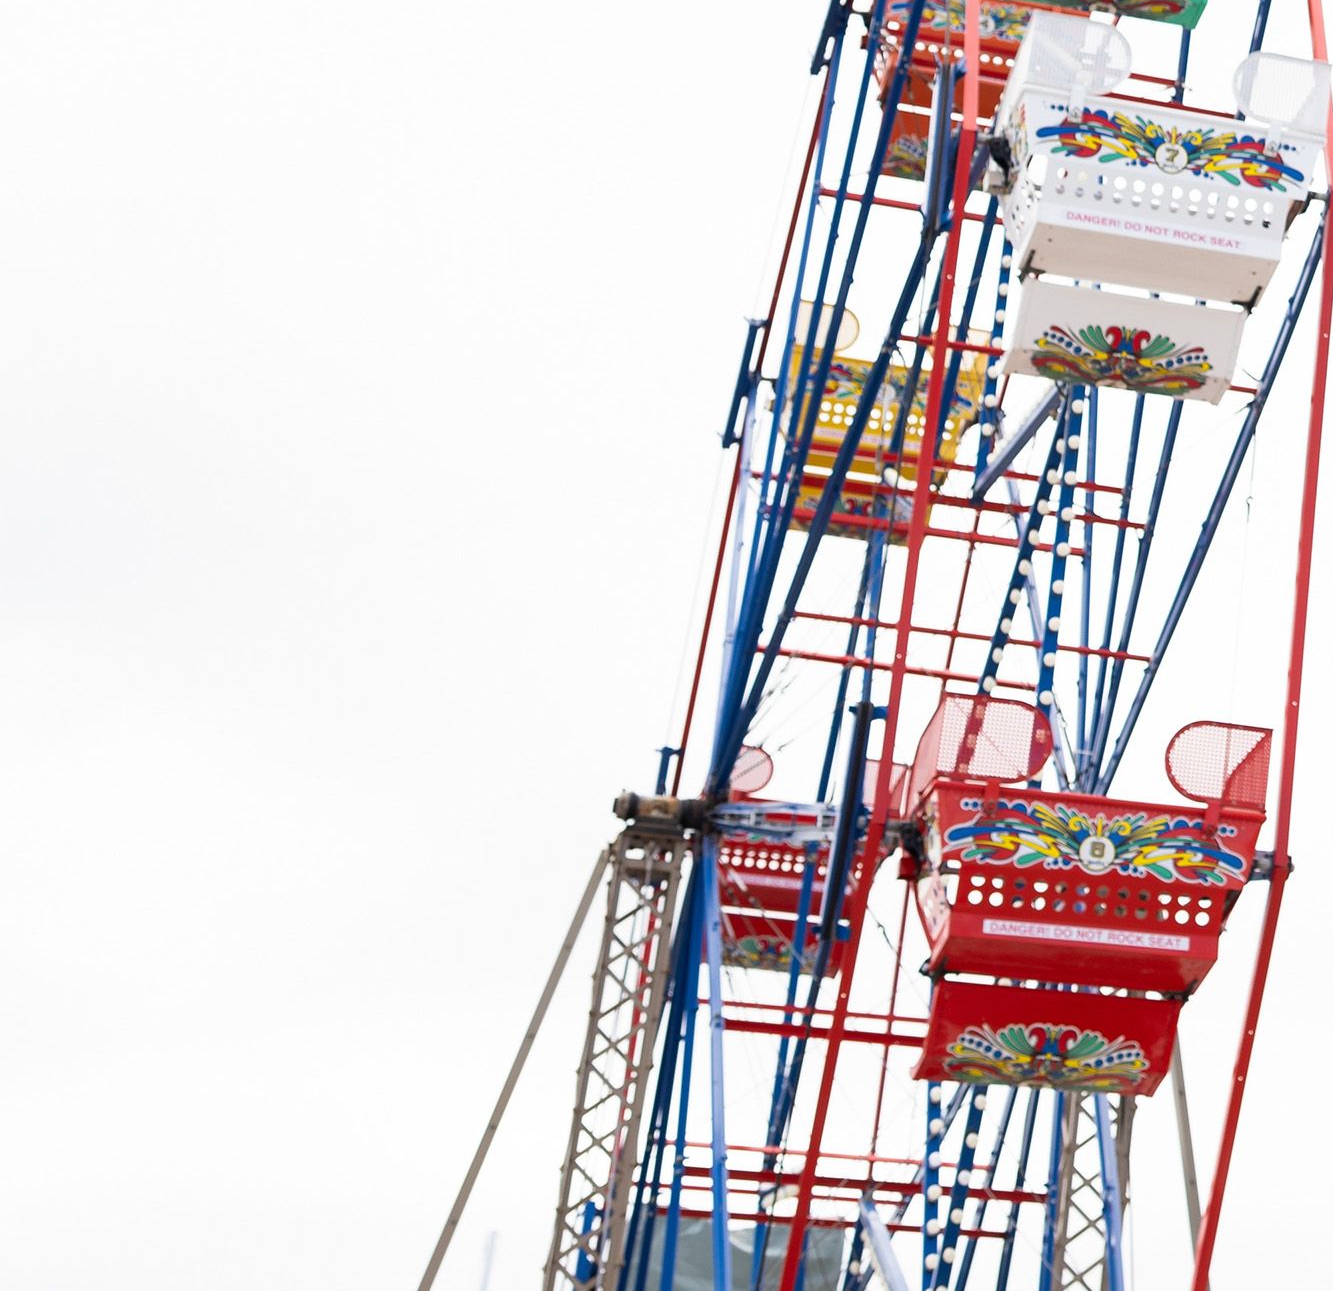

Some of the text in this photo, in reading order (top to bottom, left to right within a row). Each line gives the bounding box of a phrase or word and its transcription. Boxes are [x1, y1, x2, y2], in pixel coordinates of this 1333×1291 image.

[1165, 147, 1179, 163] 7
[1066, 210, 1241, 249] DANGER! DO NOT ROCK SEAT
[989, 921, 1182, 948] DANGER! DO NOT ROCK SEAT
